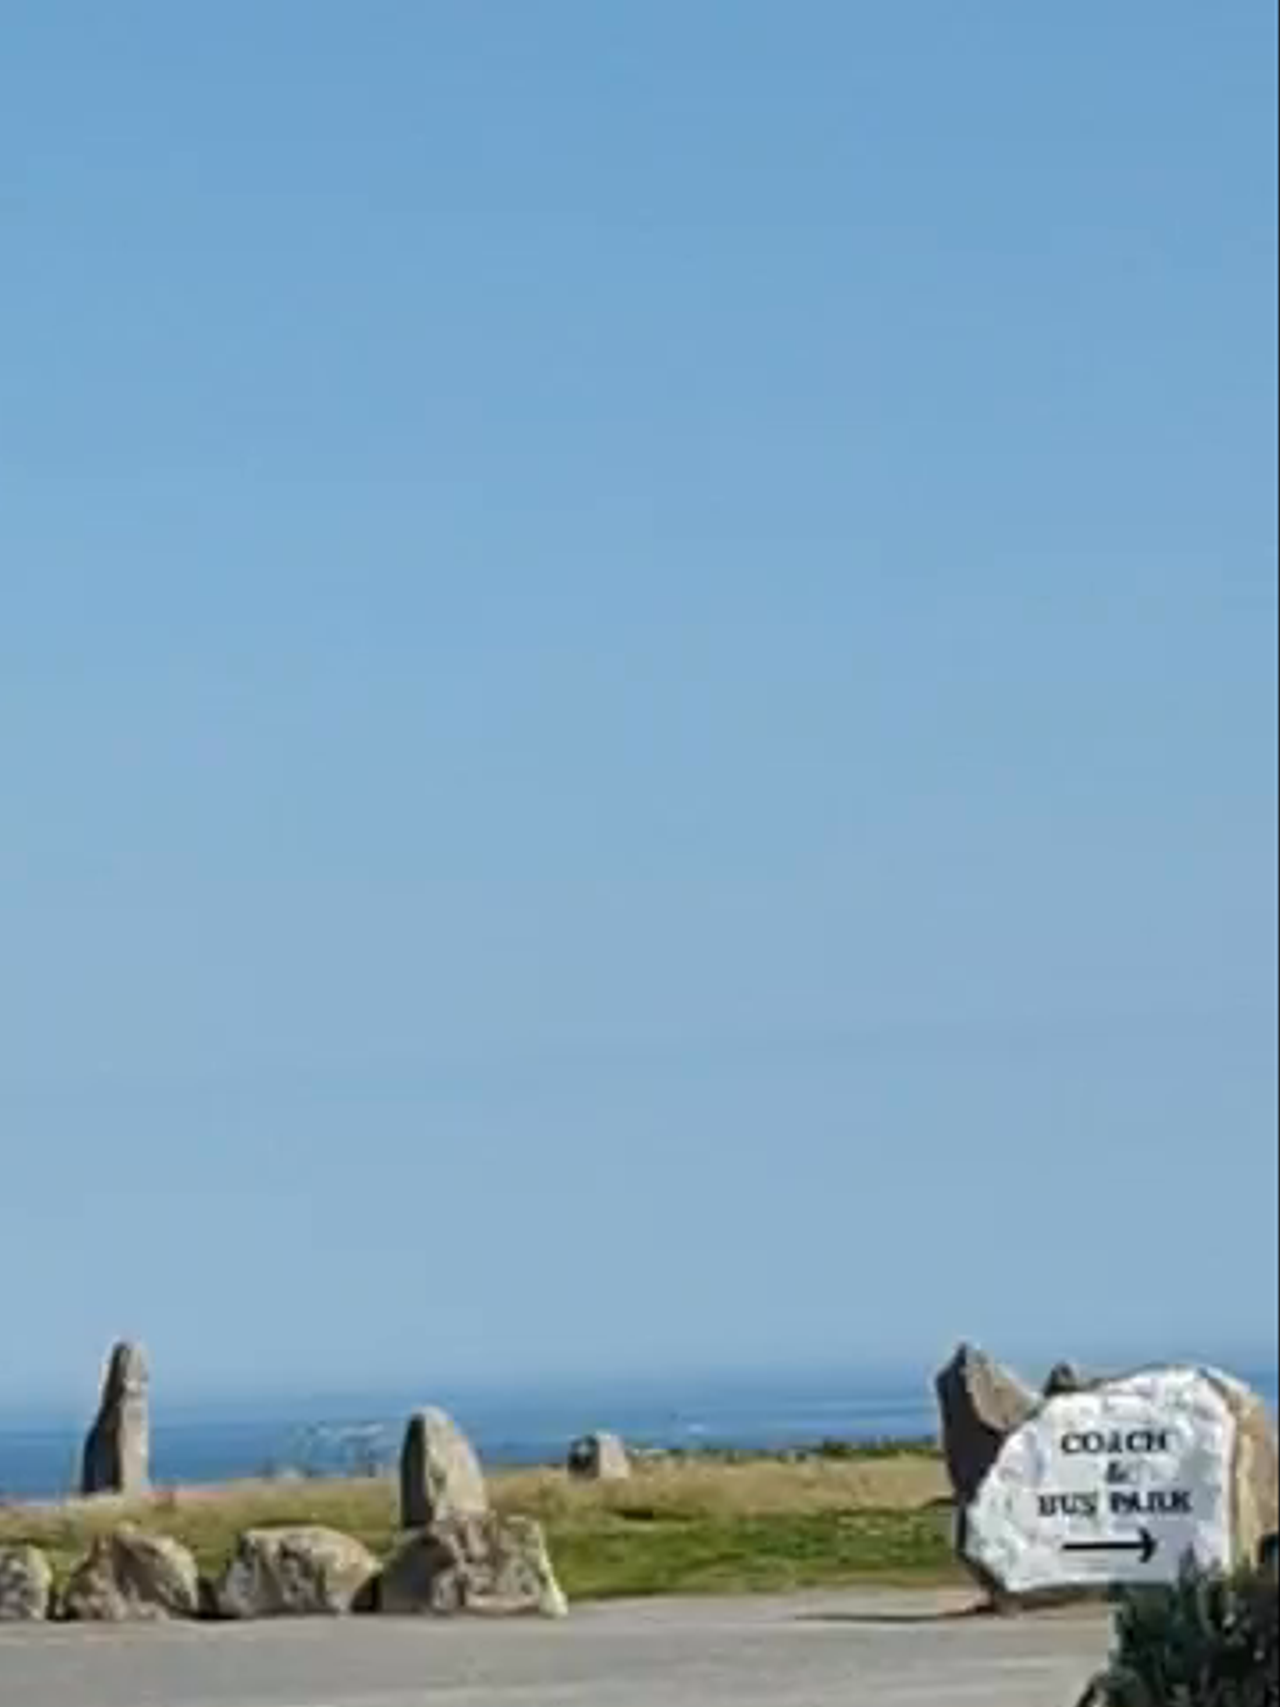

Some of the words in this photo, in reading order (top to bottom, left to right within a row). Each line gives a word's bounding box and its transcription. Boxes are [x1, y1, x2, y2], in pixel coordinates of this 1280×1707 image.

[1060, 1430, 1168, 1454] COACH
[1106, 1461, 1130, 1484] &
[1037, 1493, 1097, 1516] BUS
[1109, 1490, 1193, 1513] PARK
